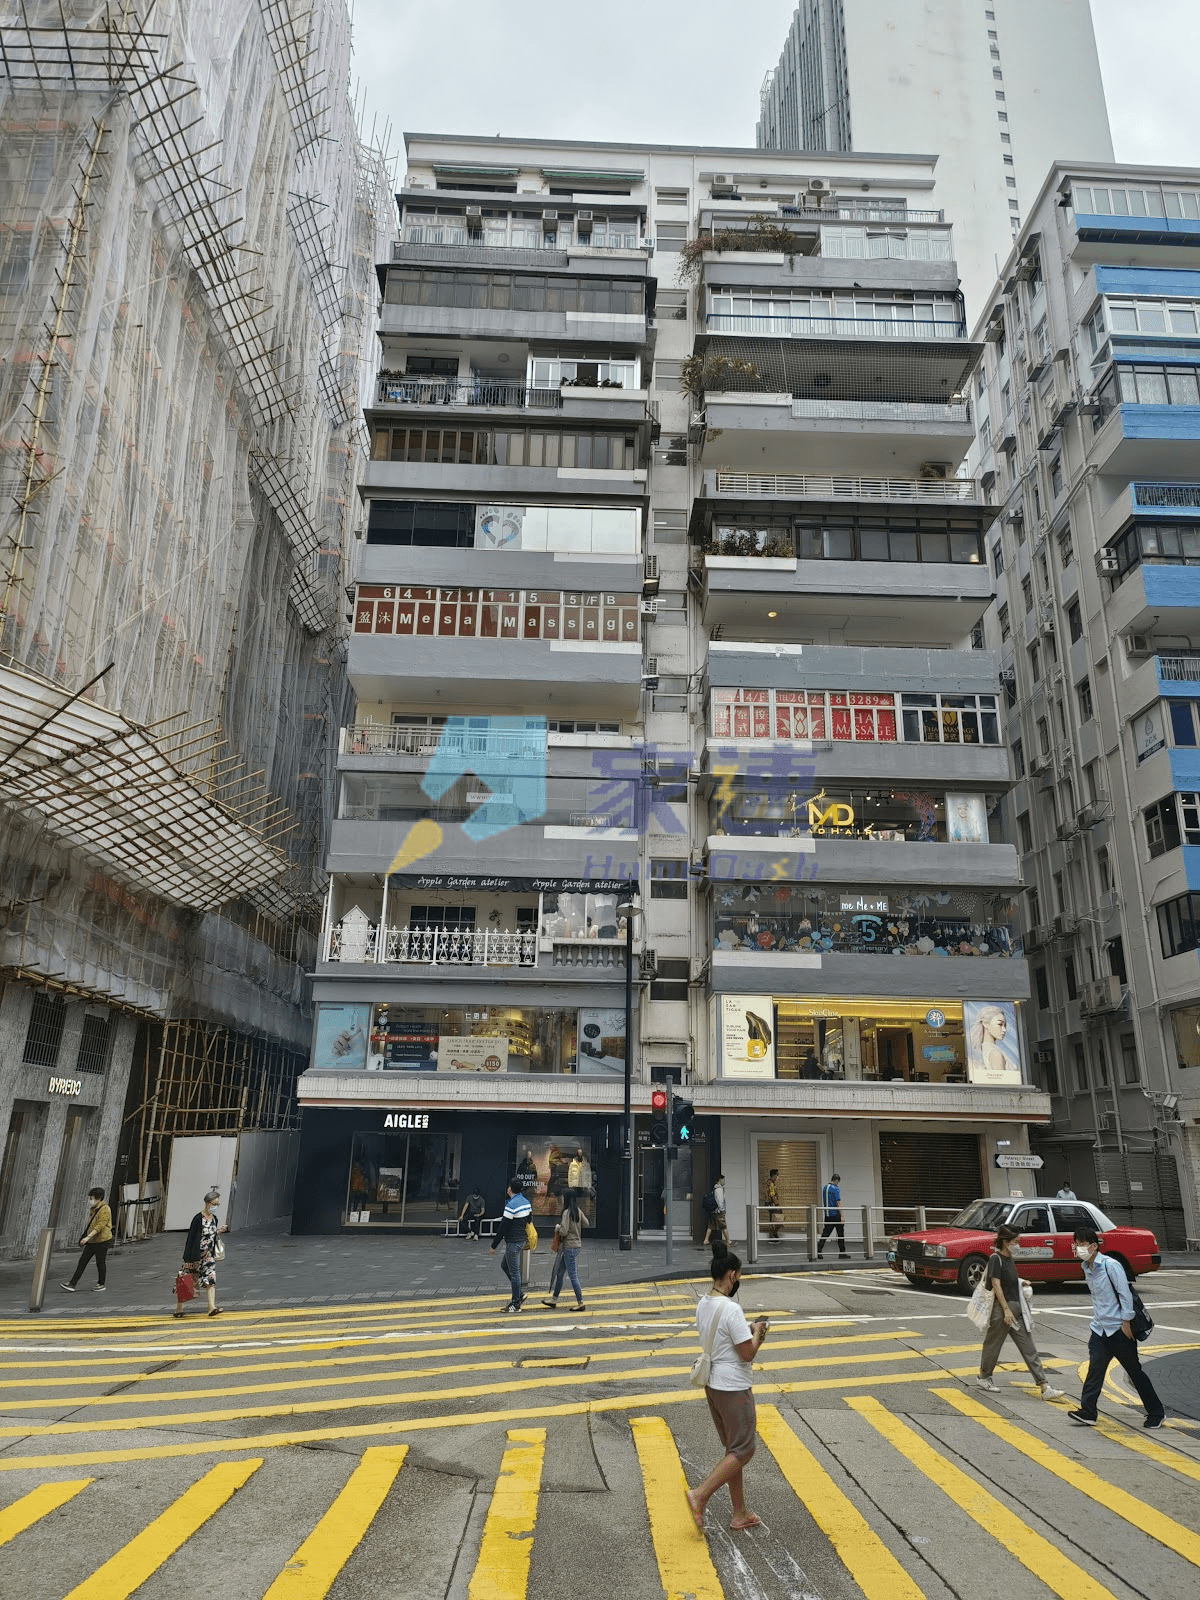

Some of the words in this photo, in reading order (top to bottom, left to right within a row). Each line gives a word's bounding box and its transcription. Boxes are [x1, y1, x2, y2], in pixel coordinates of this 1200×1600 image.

[606, 595, 616, 604] B
[399, 613, 472, 625] Mesa
[503, 616, 635, 631] Massage
[745, 692, 765, 702] 4/F
[840, 710, 881, 724] THAI
[835, 722, 892, 736] MASSAGE
[808, 803, 855, 826] MD
[417, 875, 443, 886] Apple
[447, 876, 477, 889] Garden
[480, 878, 510, 887] atelier
[532, 879, 557, 890] Apple
[561, 881, 590, 893] Garden
[594, 882, 625, 890] atelier
[856, 896, 868, 911] Me
[876, 901, 888, 912] ME
[49, 1077, 81, 1096] BYREDO
[384, 1113, 422, 1128] AIGLE
